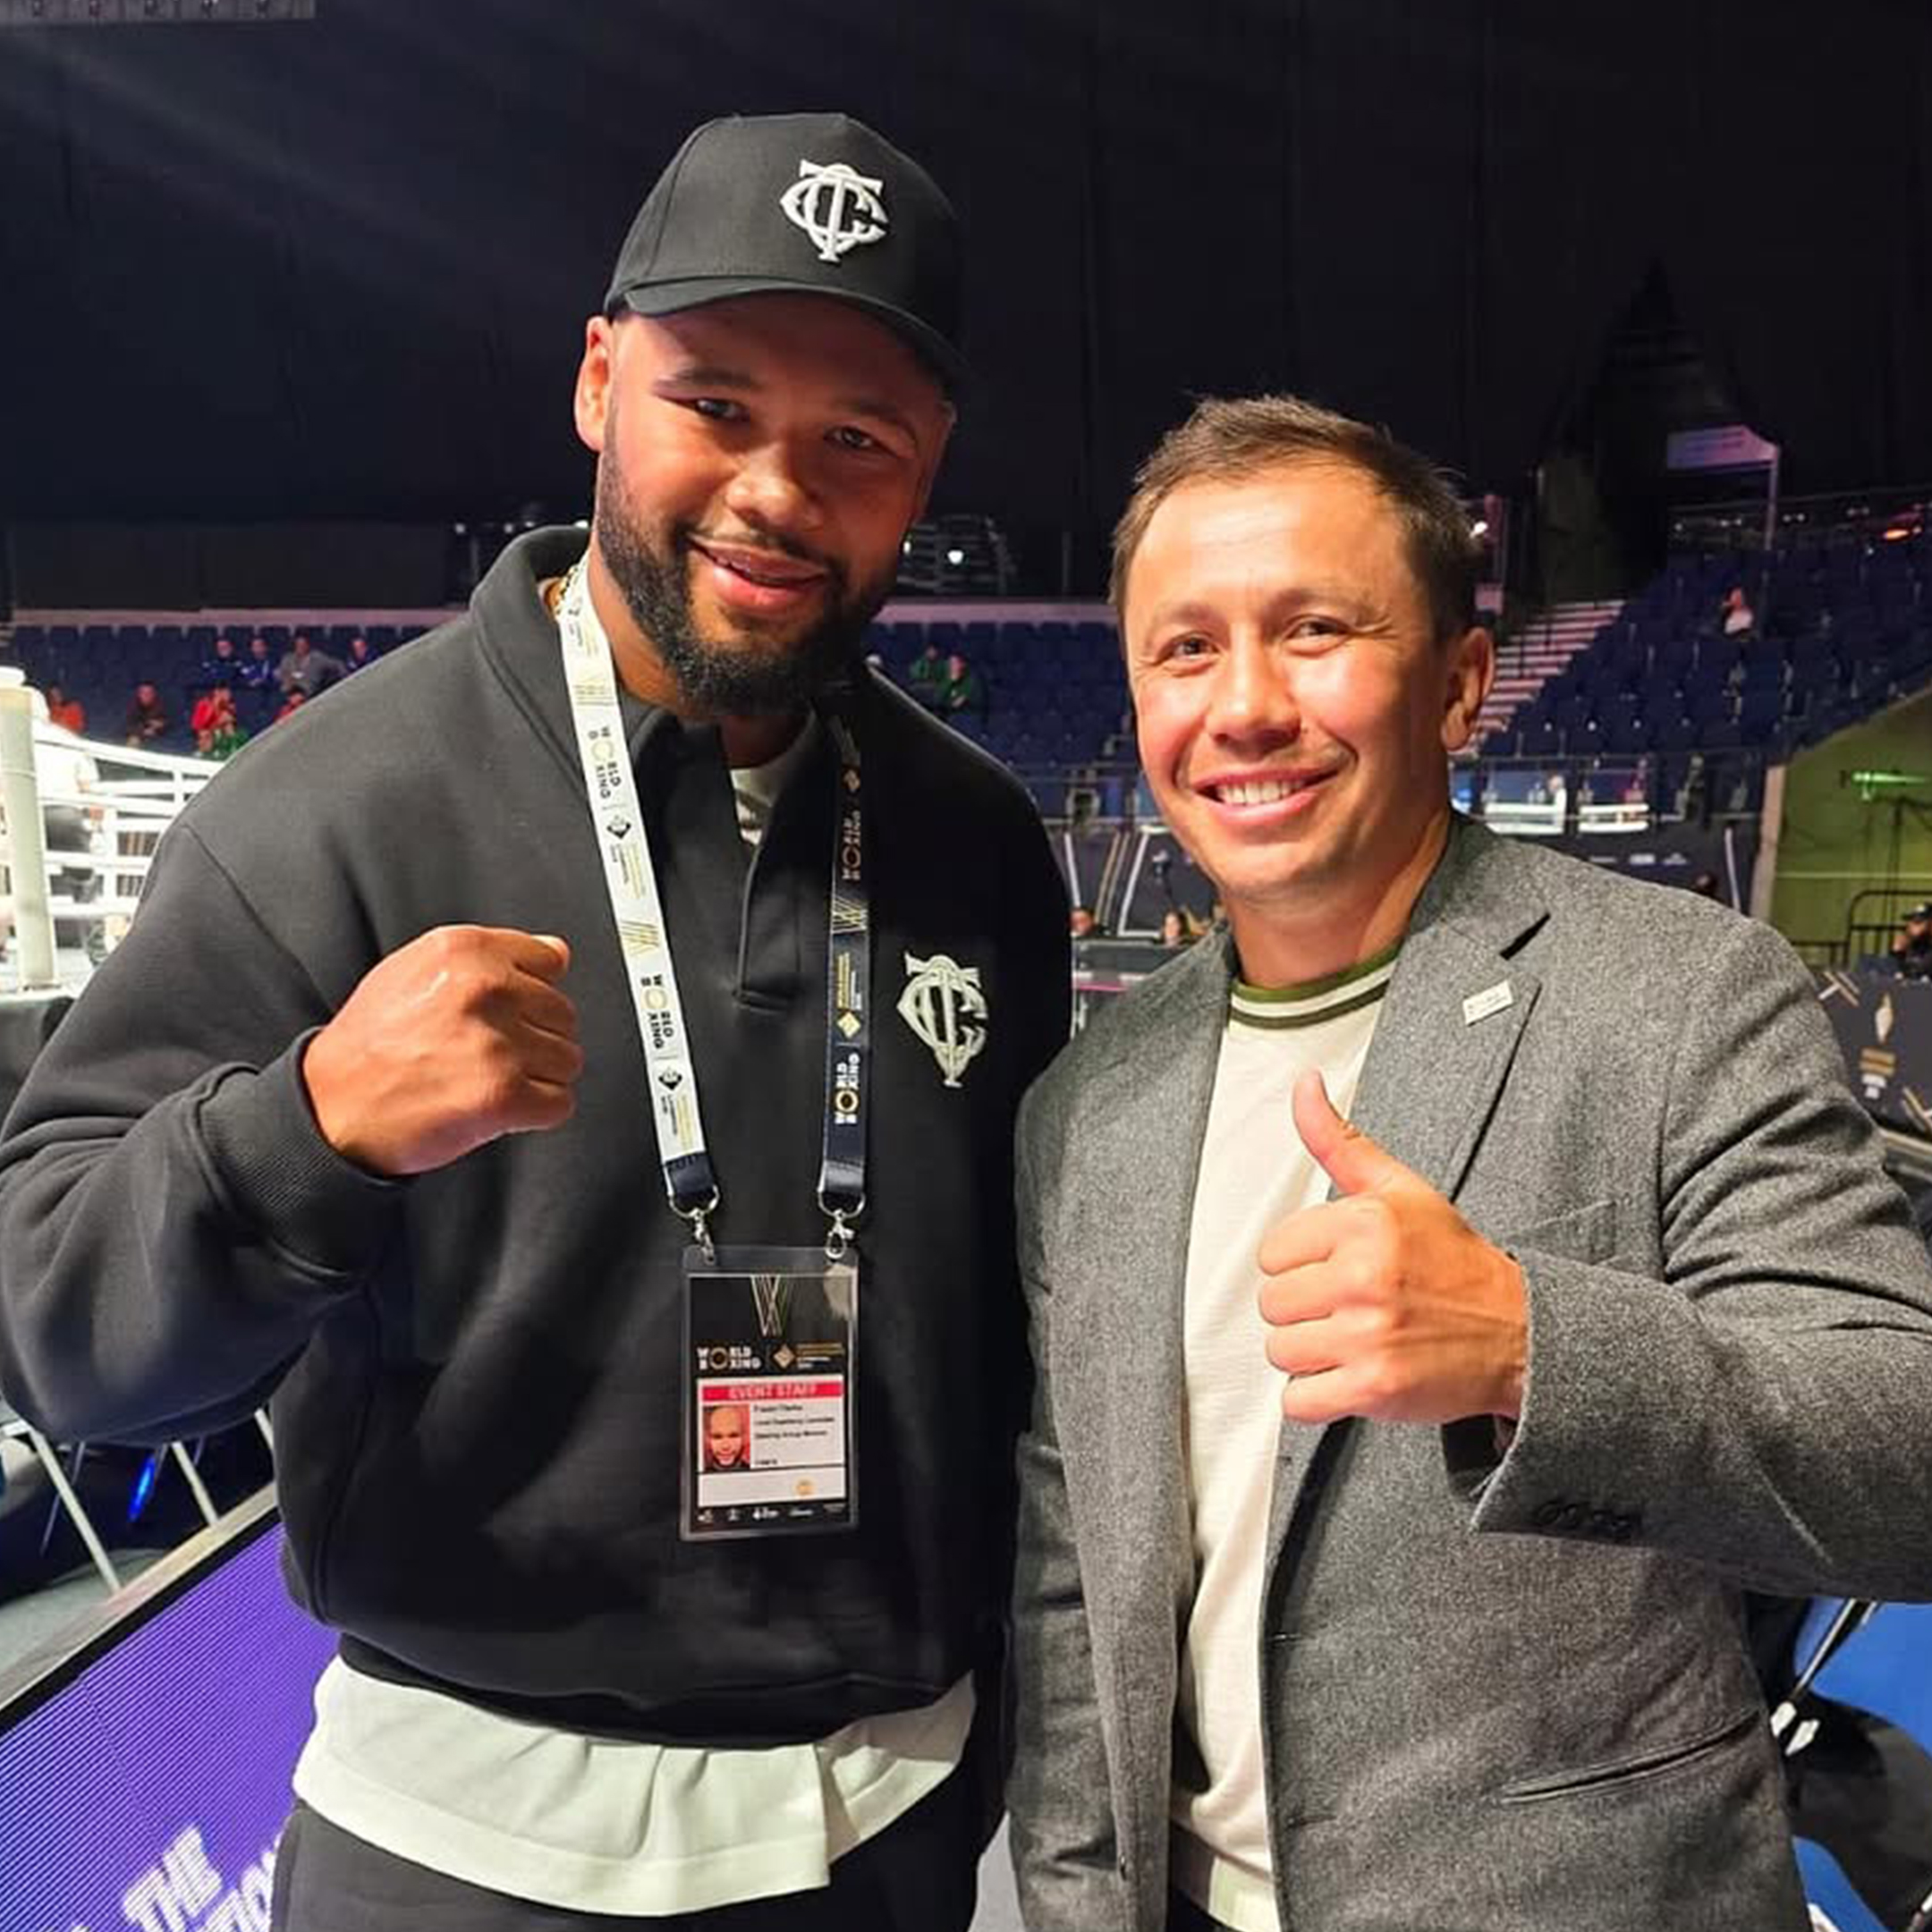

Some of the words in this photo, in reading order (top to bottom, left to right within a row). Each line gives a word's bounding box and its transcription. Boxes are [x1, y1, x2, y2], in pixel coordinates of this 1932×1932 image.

[728, 1386, 773, 1401] EVENT
[776, 1384, 817, 1398] STAFF
[122, 1824, 224, 1932] THE
